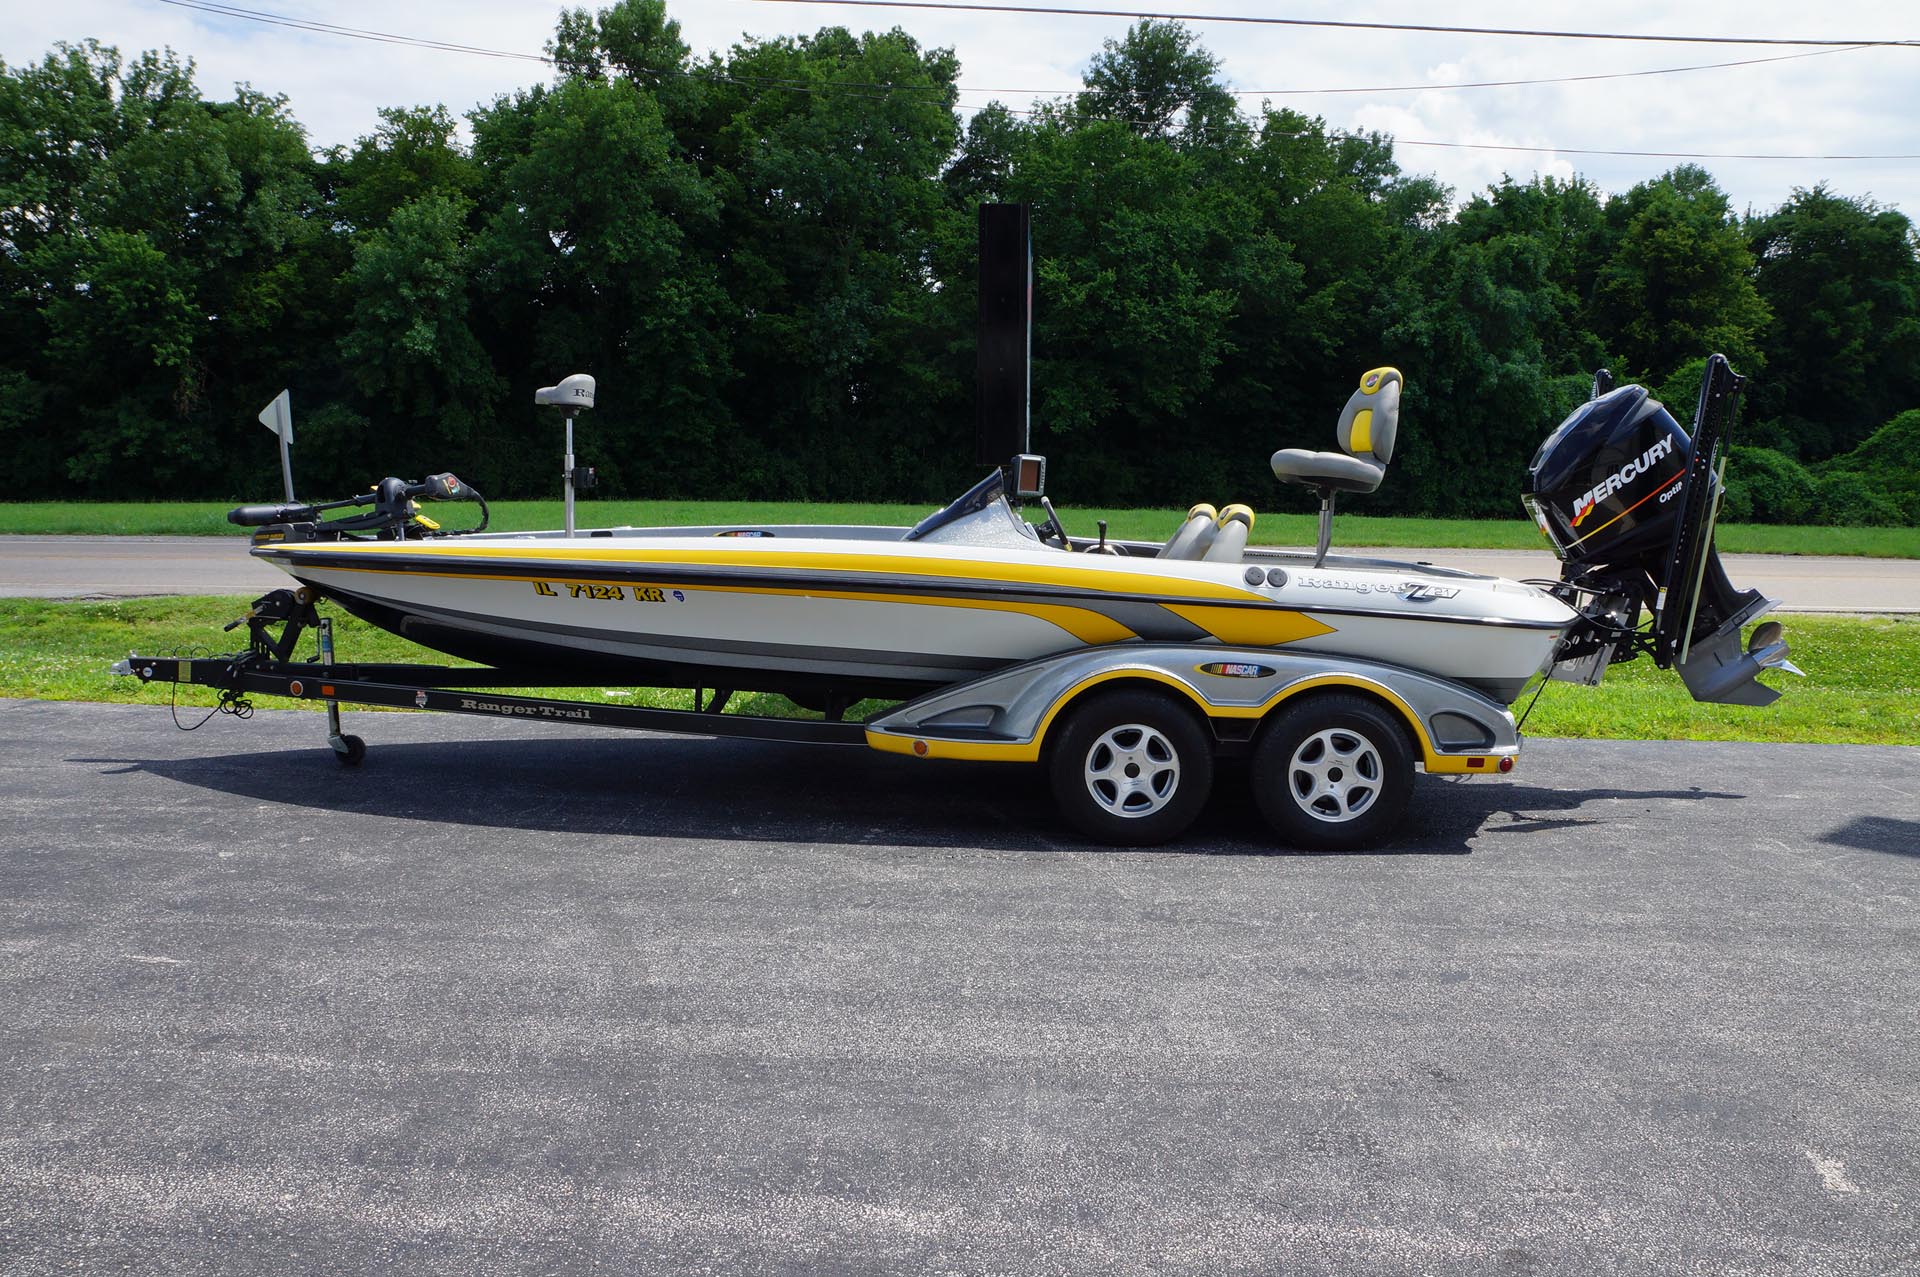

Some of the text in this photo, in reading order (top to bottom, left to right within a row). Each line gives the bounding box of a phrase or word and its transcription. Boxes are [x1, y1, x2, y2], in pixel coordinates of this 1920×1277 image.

[1571, 433, 1673, 521] MERCURY
[533, 582, 665, 602] IL 7124 KR
[1298, 576, 1403, 594] Ranger
[1226, 664, 1258, 675] NASCAR
[461, 699, 591, 719] Ranger Trail
